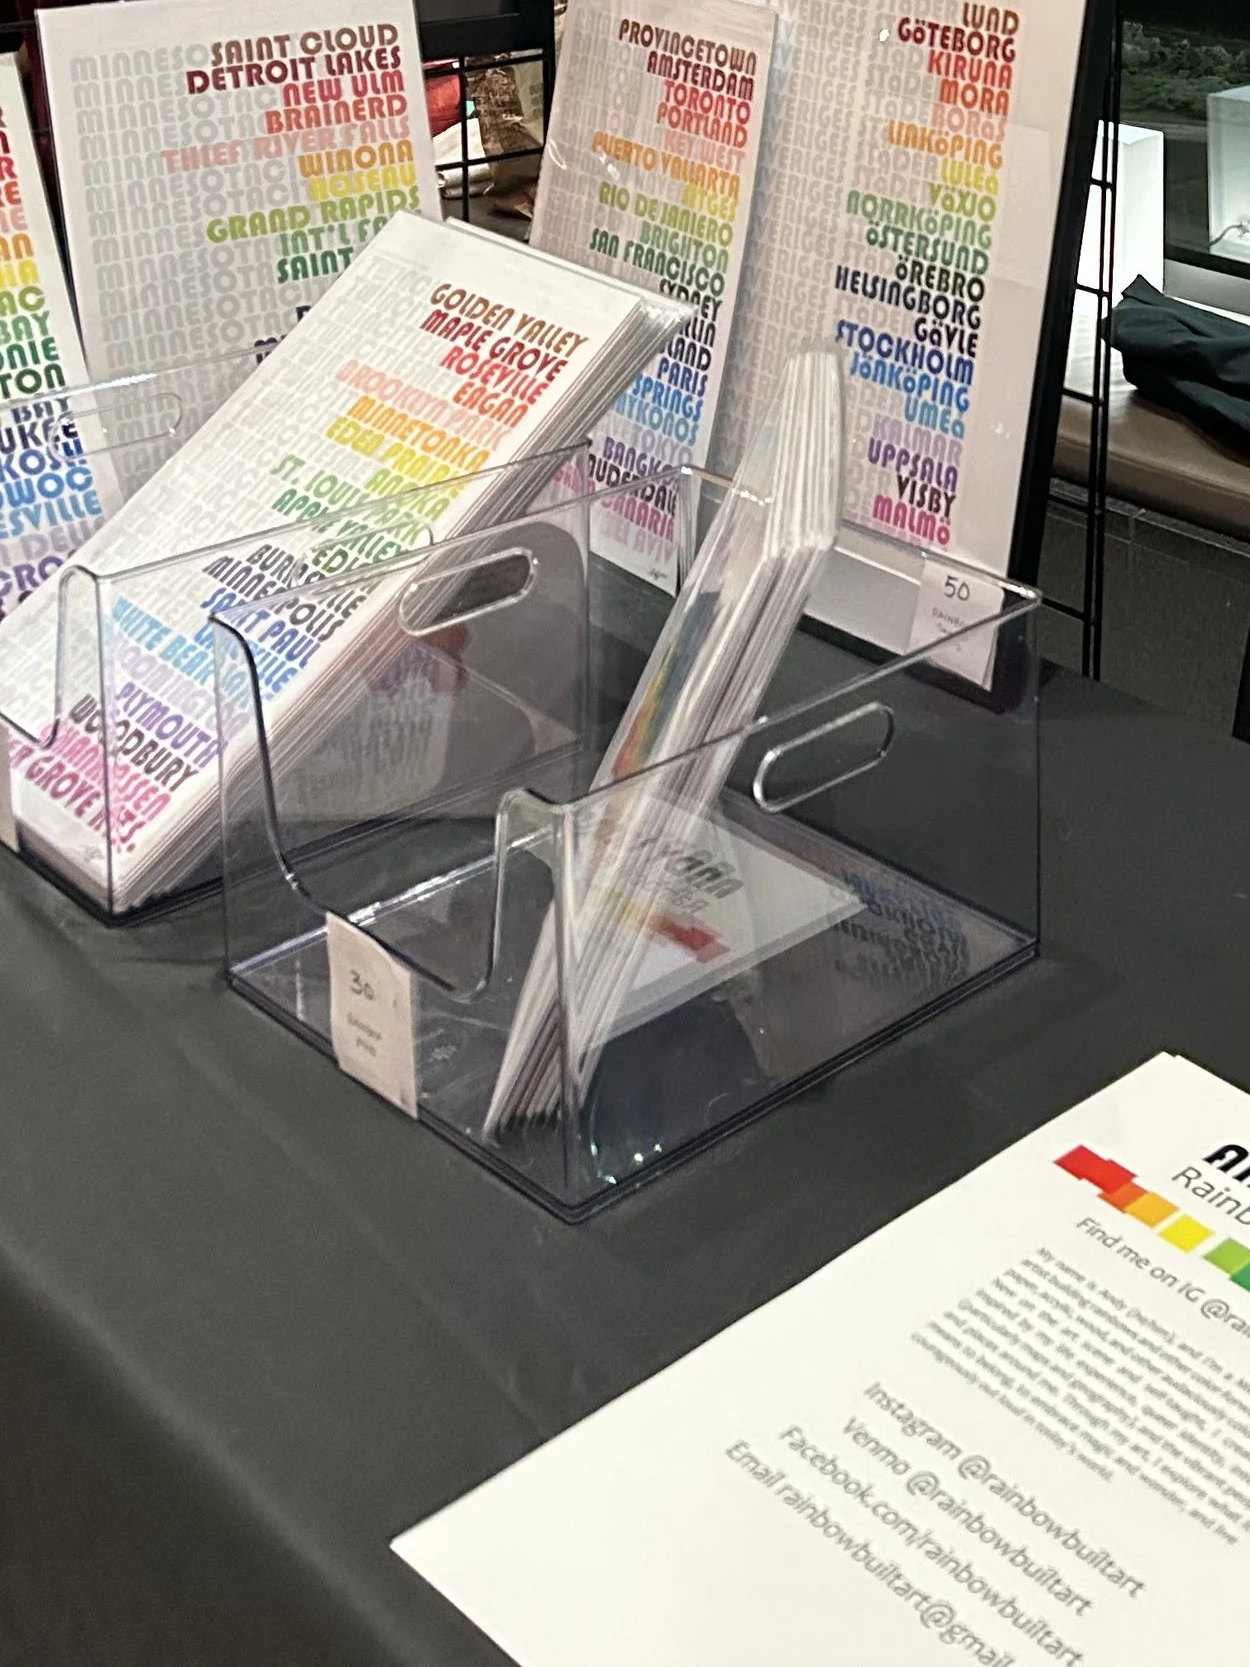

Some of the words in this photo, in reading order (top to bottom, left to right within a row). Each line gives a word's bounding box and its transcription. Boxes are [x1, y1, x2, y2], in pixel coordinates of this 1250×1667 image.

[963, 2, 1019, 35] LUND
[186, 55, 316, 95] DETROIT
[324, 45, 402, 77] LAKES
[210, 33, 291, 67] SAINT
[300, 23, 399, 56] CLOUD
[619, 18, 757, 76] PROVINCETOWN
[927, 49, 1013, 89] KIRUNA
[282, 76, 343, 108] NEW
[350, 69, 406, 100] ULM
[647, 50, 755, 101] AMSTERDAM
[939, 79, 1010, 116] MORA
[264, 93, 408, 135] BRAINERD
[656, 101, 747, 149] PORTLAND
[664, 79, 751, 125] TORONTO
[252, 125, 340, 161] RIVER
[340, 114, 411, 149] FALLS
[297, 138, 415, 179] WINONA
[663, 130, 693, 156] KEY
[696, 140, 746, 172] WEST
[592, 130, 657, 172] PUERTO
[661, 150, 740, 199] VALLARTA
[206, 204, 312, 245] GRAND
[318, 184, 421, 226] RAPIDS
[599, 181, 630, 211] RIO
[634, 193, 659, 220] DE
[660, 200, 733, 248] JANIERO
[276, 246, 354, 285] SAINT
[589, 227, 621, 259] SAN
[623, 237, 725, 297] FRANCISCO
[640, 221, 729, 274] BRIGHTON
[429, 283, 515, 336] GOLDEN
[512, 312, 589, 359] VALLEY
[835, 265, 981, 330] HELSINGBORG
[419, 308, 494, 352] MAPLE
[488, 336, 569, 384] GROVE
[836, 319, 975, 385] STOCKHOLM
[335, 358, 448, 418] BROOKLYN
[438, 345, 551, 406] ROSEVILLE
[632, 371, 703, 423] SPRINGS
[657, 356, 709, 397] PARIS
[452, 381, 529, 430] EAGAN
[325, 415, 387, 458] EDEN
[346, 395, 490, 473] MINNETONKA
[872, 414, 962, 467] KALMAR
[270, 454, 306, 486] ST.
[868, 437, 959, 493] UPPSALA
[897, 473, 957, 520] VISBY
[944, 575, 970, 601] 50
[257, 618, 321, 670] PAUL
[115, 681, 228, 769] PLYMOUTH
[25, 755, 102, 818] GROVE
[1075, 1215, 1117, 1248] Find
[1115, 1237, 1151, 1269] me
[1149, 1264, 1180, 1290] on
[1177, 1277, 1208, 1304] IG
[725, 1440, 787, 1489] Email
[863, 1381, 963, 1462] Instagram
[957, 1453, 1147, 1599] @rainbowbuiltart
[842, 1415, 912, 1476] Venmo
[906, 1470, 1093, 1617] @rainbowbuiltart
[778, 1424, 1084, 1667] Facebook.com/rainbowbuiltart
